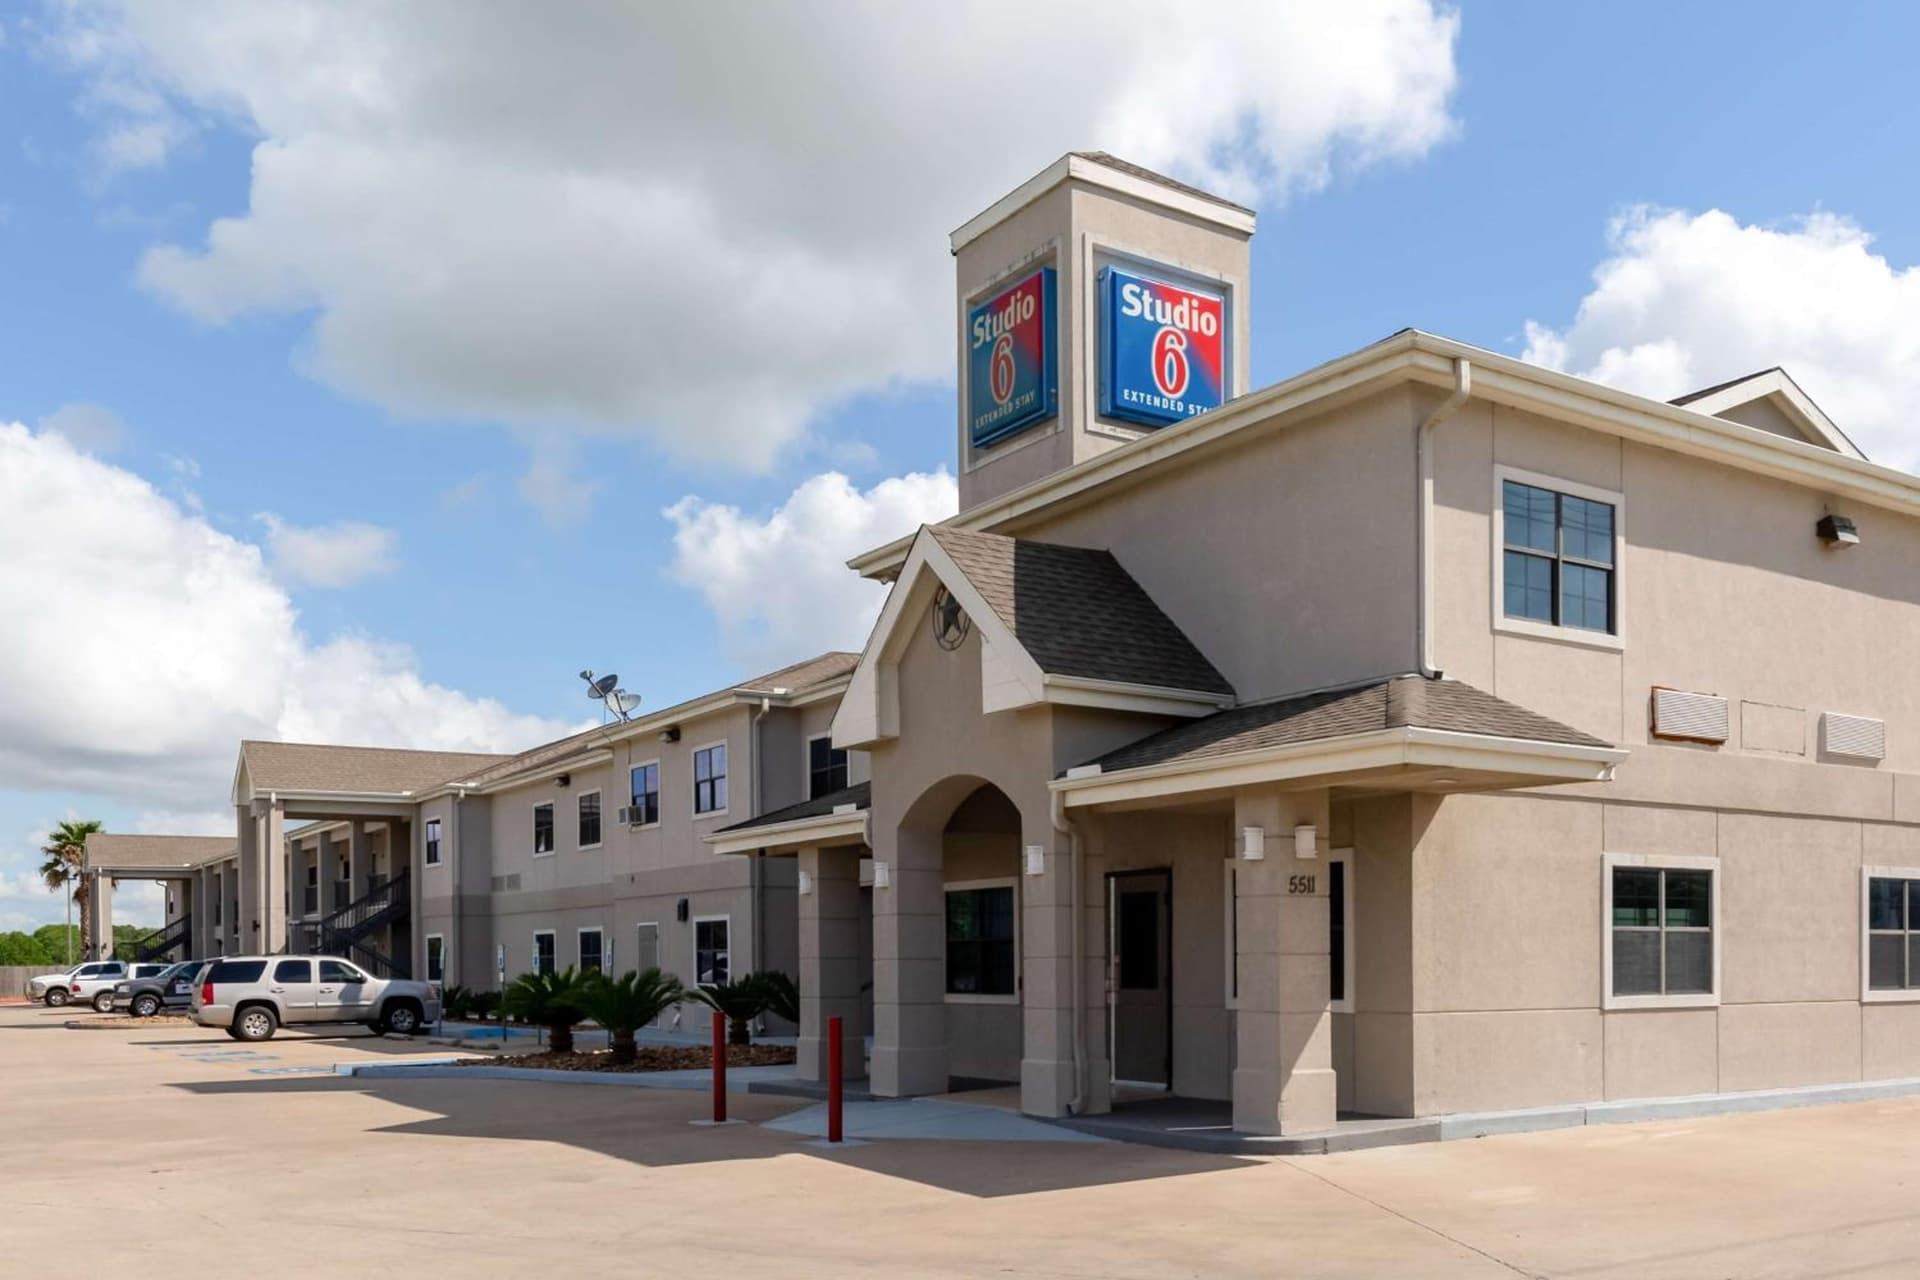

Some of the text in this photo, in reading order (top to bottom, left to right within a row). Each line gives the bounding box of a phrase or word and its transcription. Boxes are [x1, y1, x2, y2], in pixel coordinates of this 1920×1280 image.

[973, 290, 1035, 348] Studio
[1121, 283, 1217, 336] Studio
[990, 332, 1015, 404] 6
[1152, 326, 1189, 399] 6
[975, 389, 1035, 429] EXTENDED STAY
[1123, 388, 1214, 416] EXTENDED STA
[1288, 875, 1316, 894] 5511
